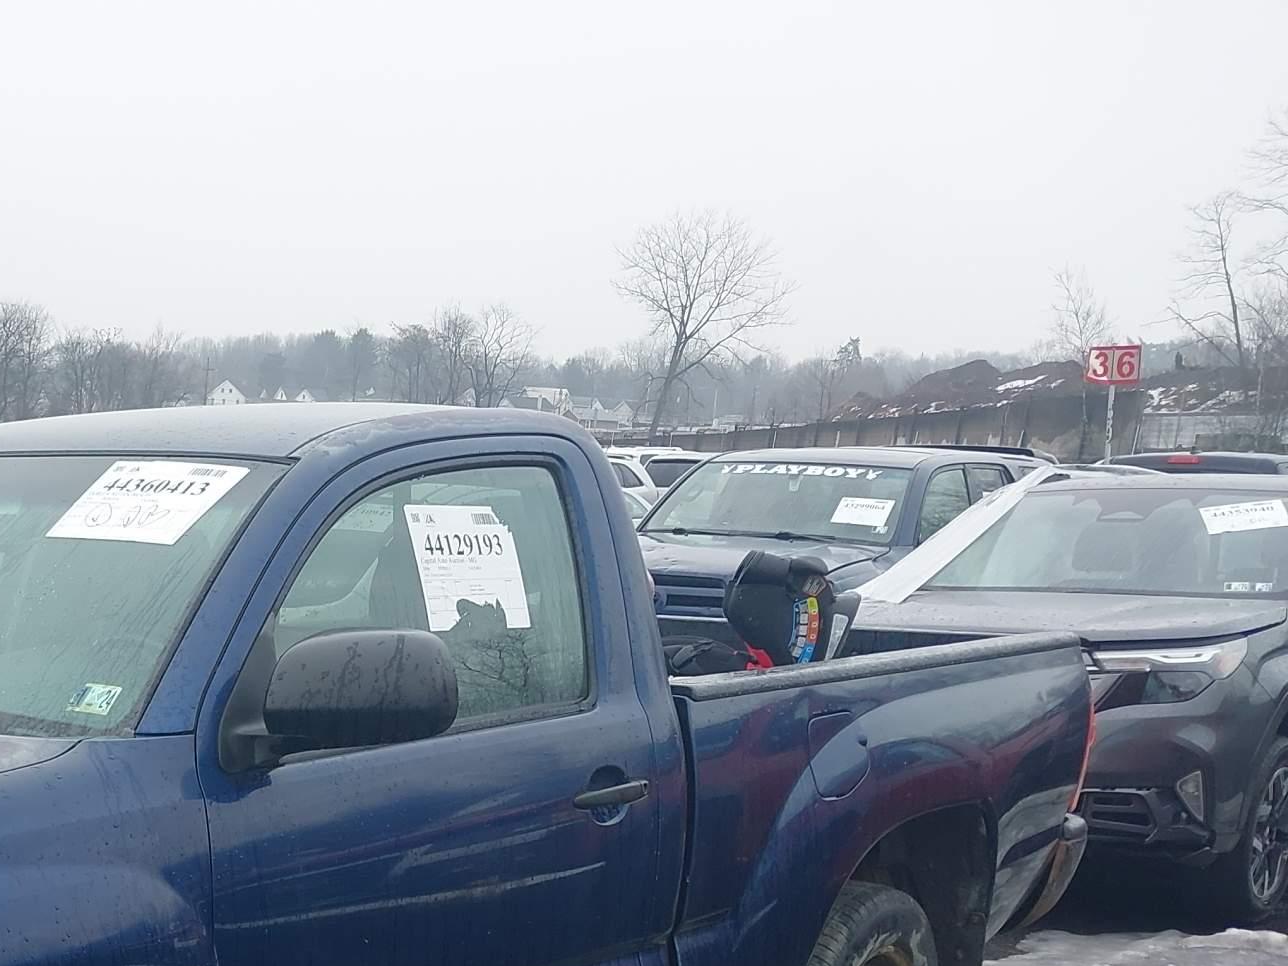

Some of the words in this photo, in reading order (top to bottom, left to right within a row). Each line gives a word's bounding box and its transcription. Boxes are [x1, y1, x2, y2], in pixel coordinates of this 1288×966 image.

[1092, 351, 1136, 378] 36
[733, 463, 866, 479] PLAYBOY
[103, 478, 211, 496] 44360413
[424, 533, 504, 556] 44129193
